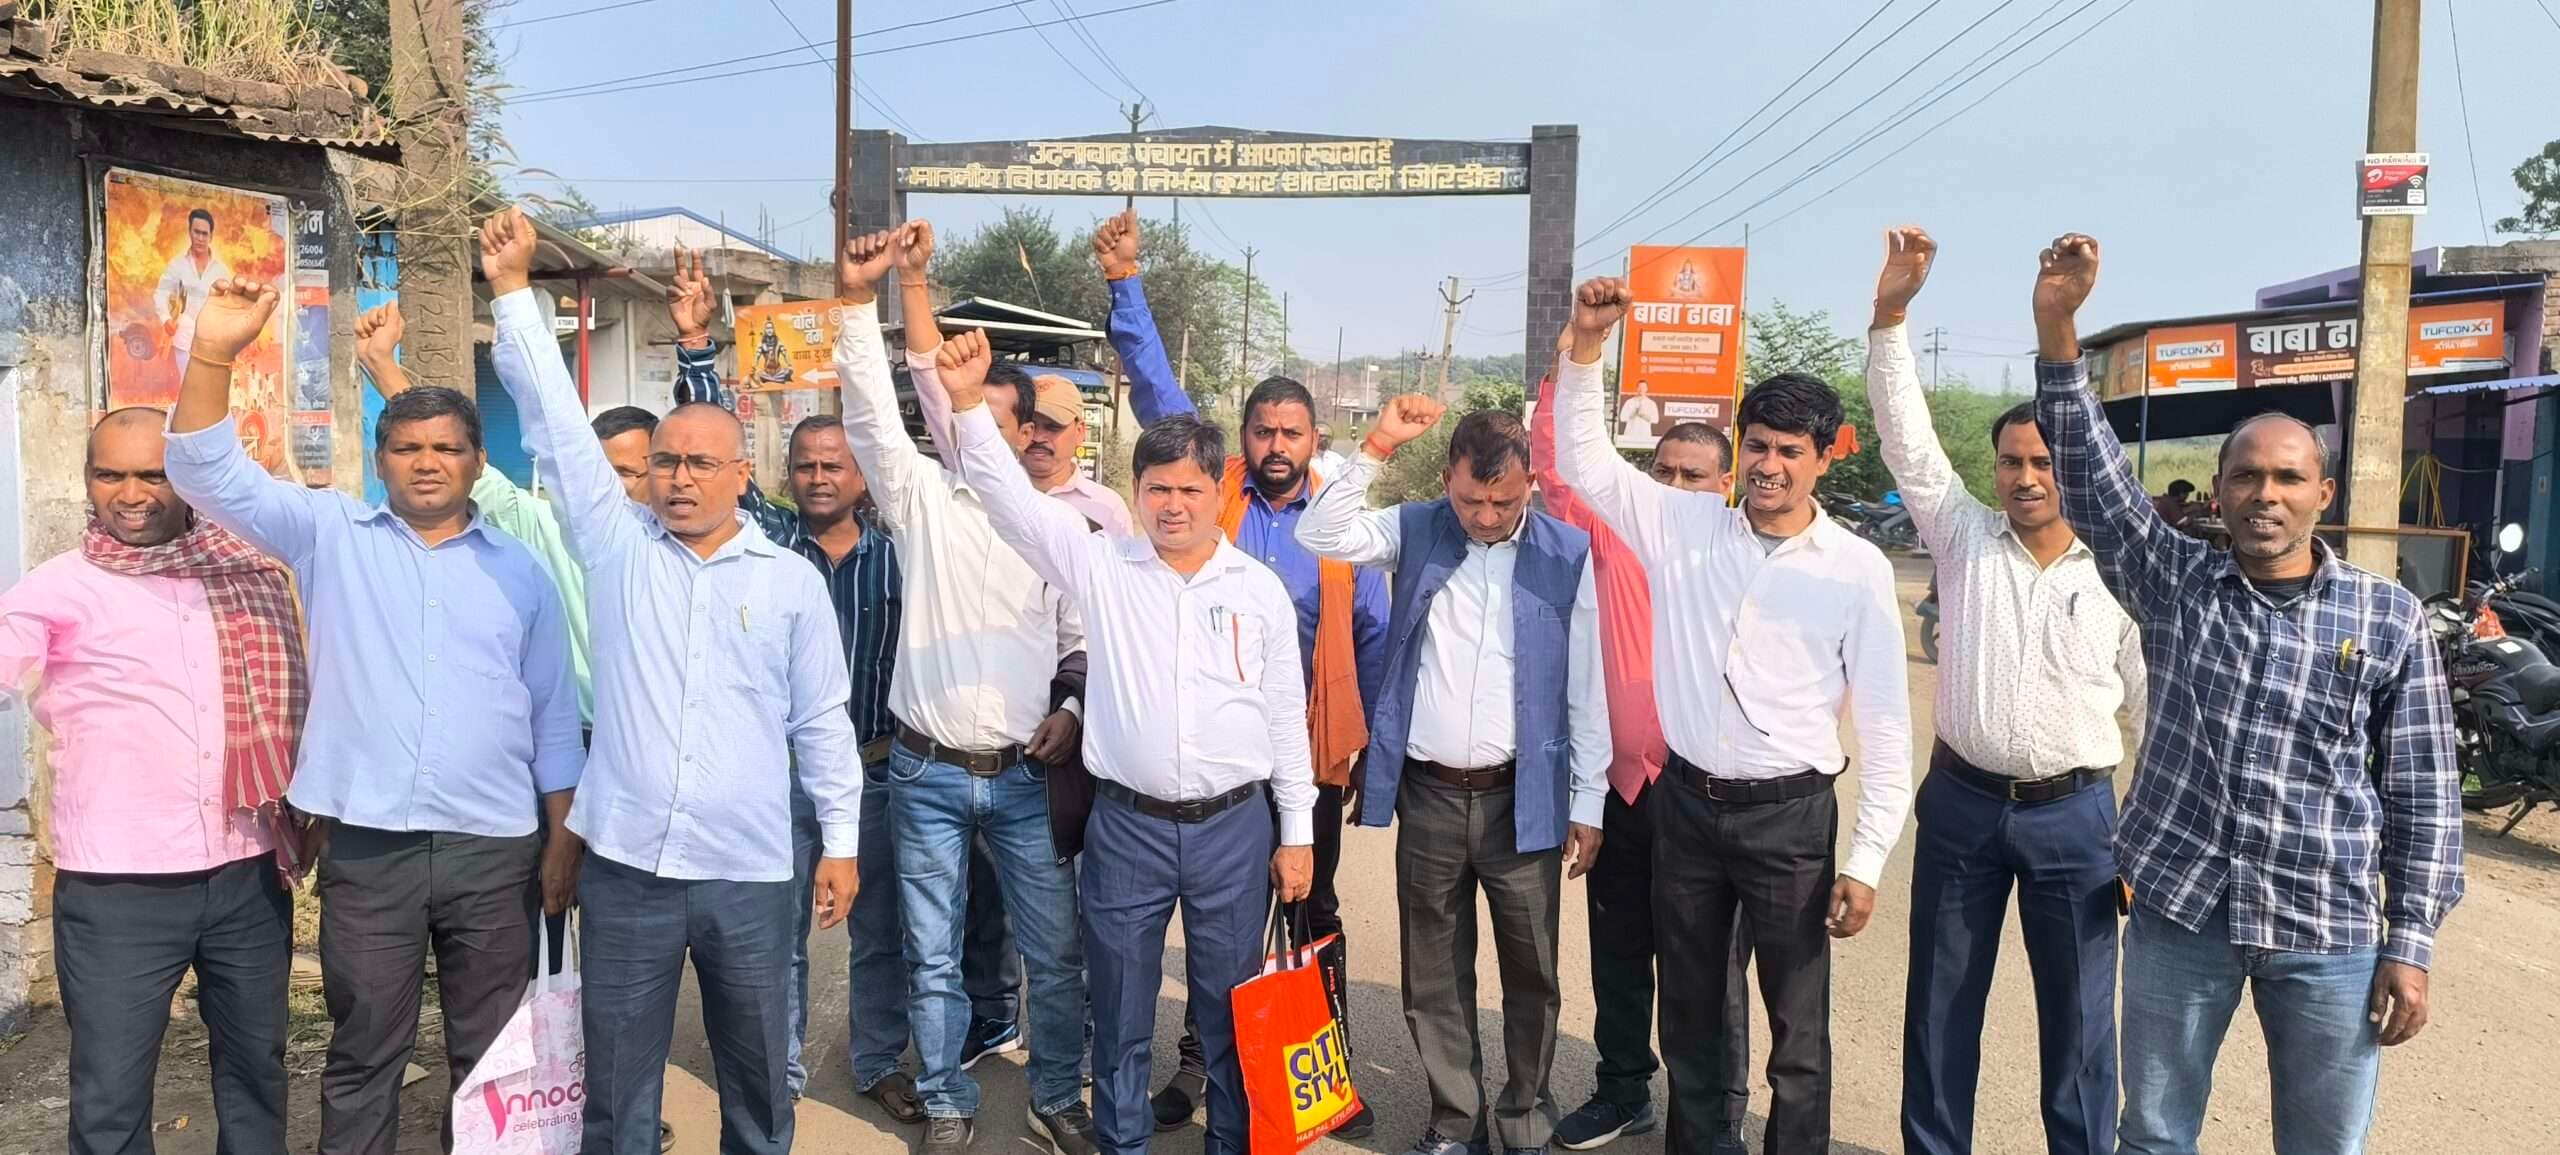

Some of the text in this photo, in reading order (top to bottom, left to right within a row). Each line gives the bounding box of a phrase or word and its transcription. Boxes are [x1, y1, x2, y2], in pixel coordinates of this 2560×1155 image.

[1133, 137, 1211, 166] पंचायत
[1237, 143, 1304, 167] आपका
[1107, 167, 1137, 191] श्री
[1214, 171, 1279, 194] कुमार
[1632, 302, 1736, 326] बाबा ढाबा
[2246, 319, 2357, 354] बाबा ढा
[1289, 1026, 1340, 1081] CITI
[512, 1111, 578, 1133] celebrating
